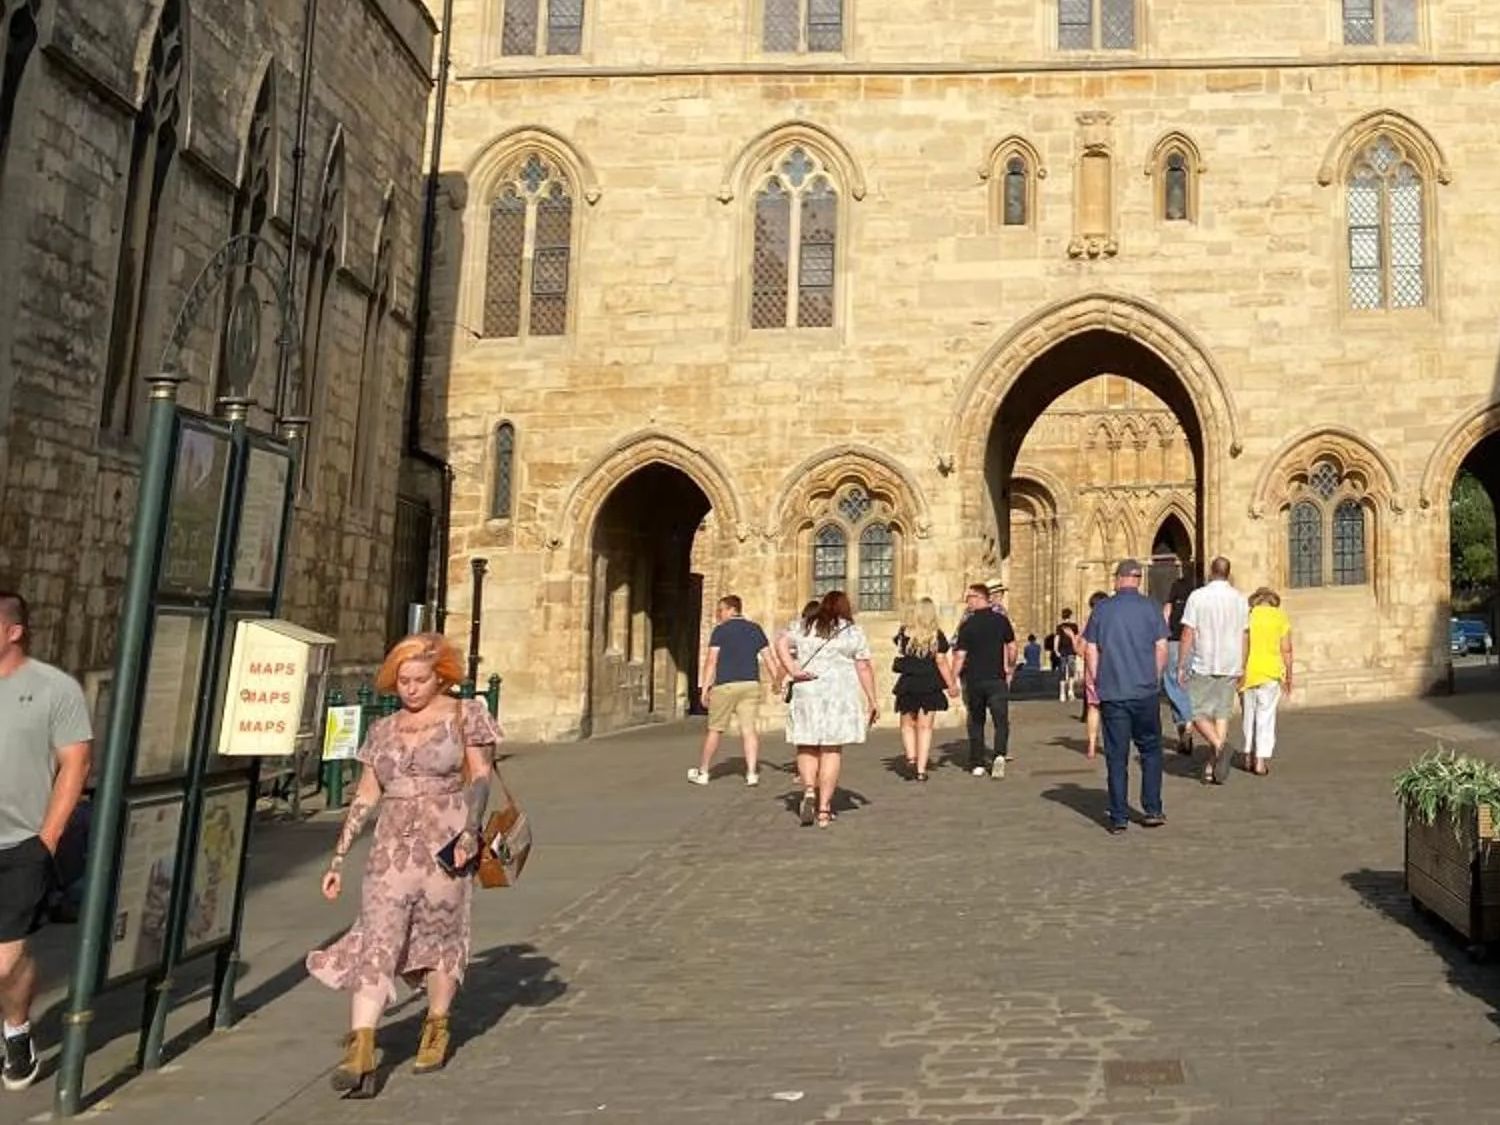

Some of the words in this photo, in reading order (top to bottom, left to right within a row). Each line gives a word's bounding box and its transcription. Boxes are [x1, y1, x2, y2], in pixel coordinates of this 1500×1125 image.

[249, 662, 295, 676] MAPS
[247, 690, 290, 704] MAPS
[239, 720, 286, 733] MAPS
